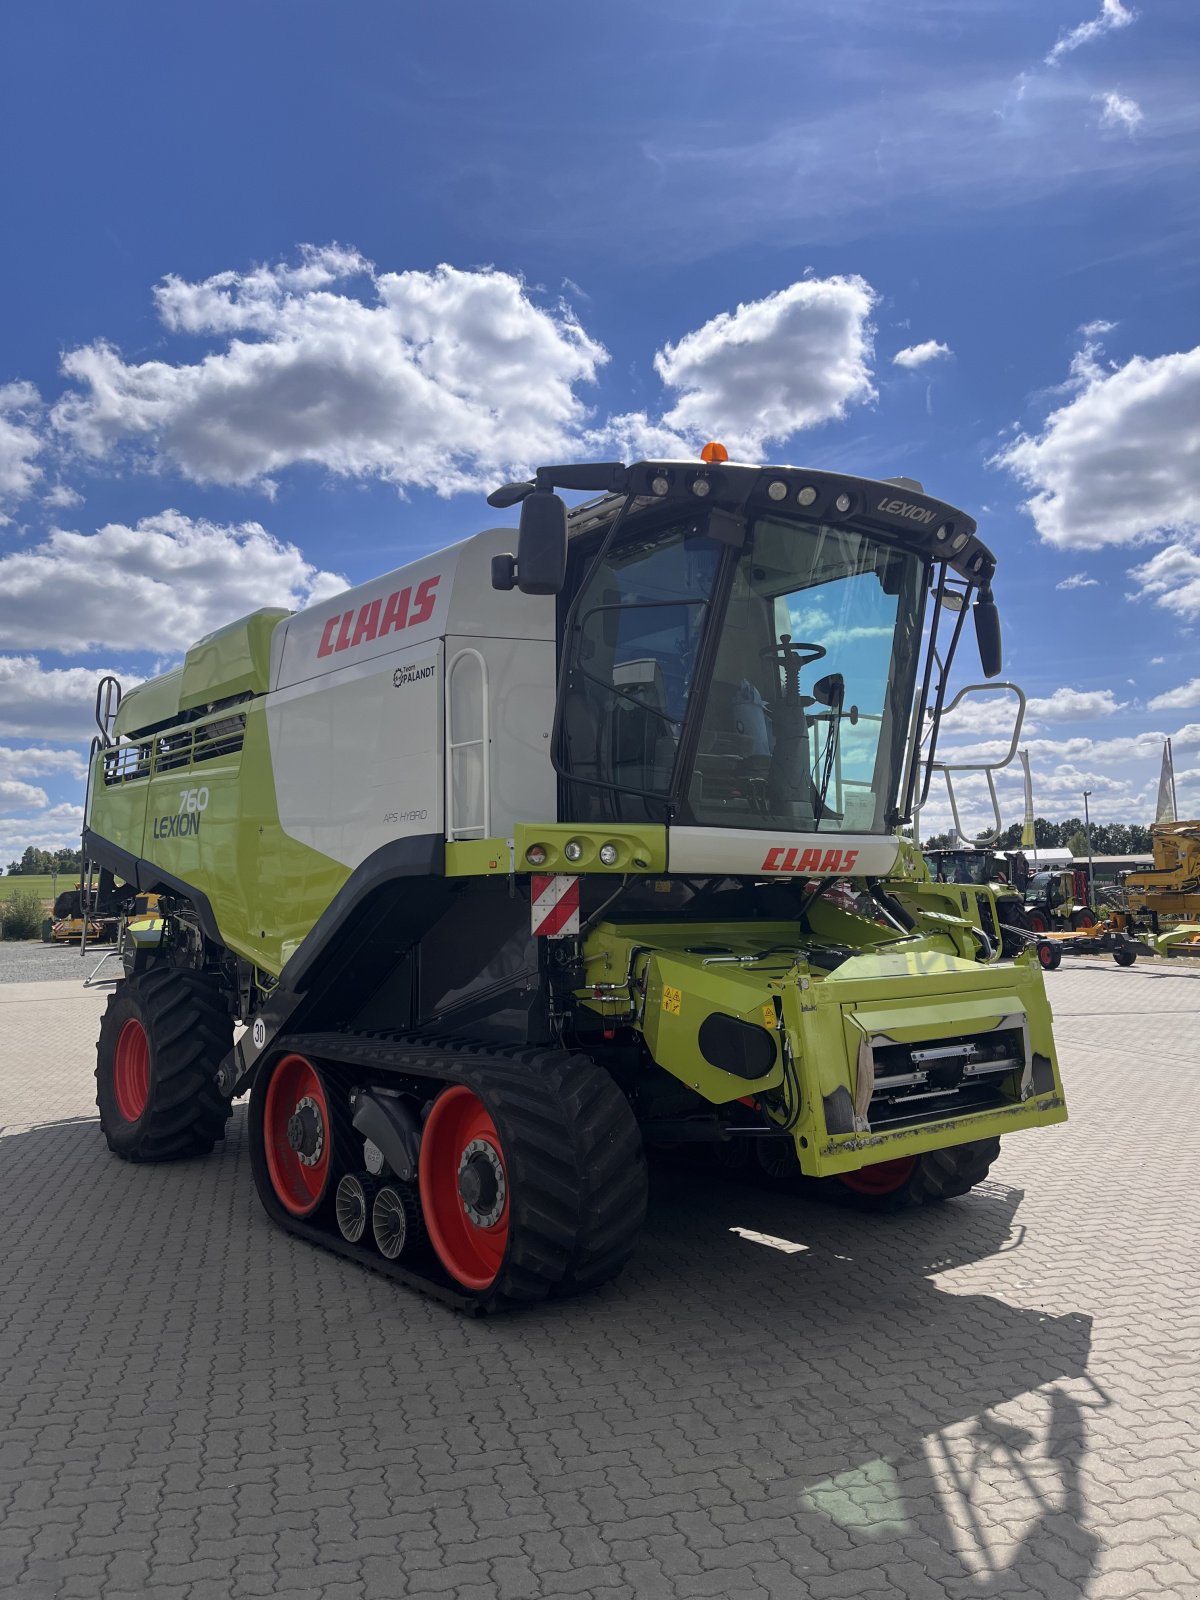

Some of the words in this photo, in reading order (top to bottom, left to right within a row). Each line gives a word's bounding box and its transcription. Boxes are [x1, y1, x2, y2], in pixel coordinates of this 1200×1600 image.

[877, 497, 937, 524] LEXION
[317, 574, 441, 659] CLAAS
[403, 666, 435, 683] PALANDT
[179, 786, 209, 814] 760
[153, 812, 201, 839] LEXION
[383, 812, 399, 823] APS
[400, 809, 428, 822] HYBRID
[761, 848, 859, 872] CLAAS
[255, 1023, 264, 1044] 30
